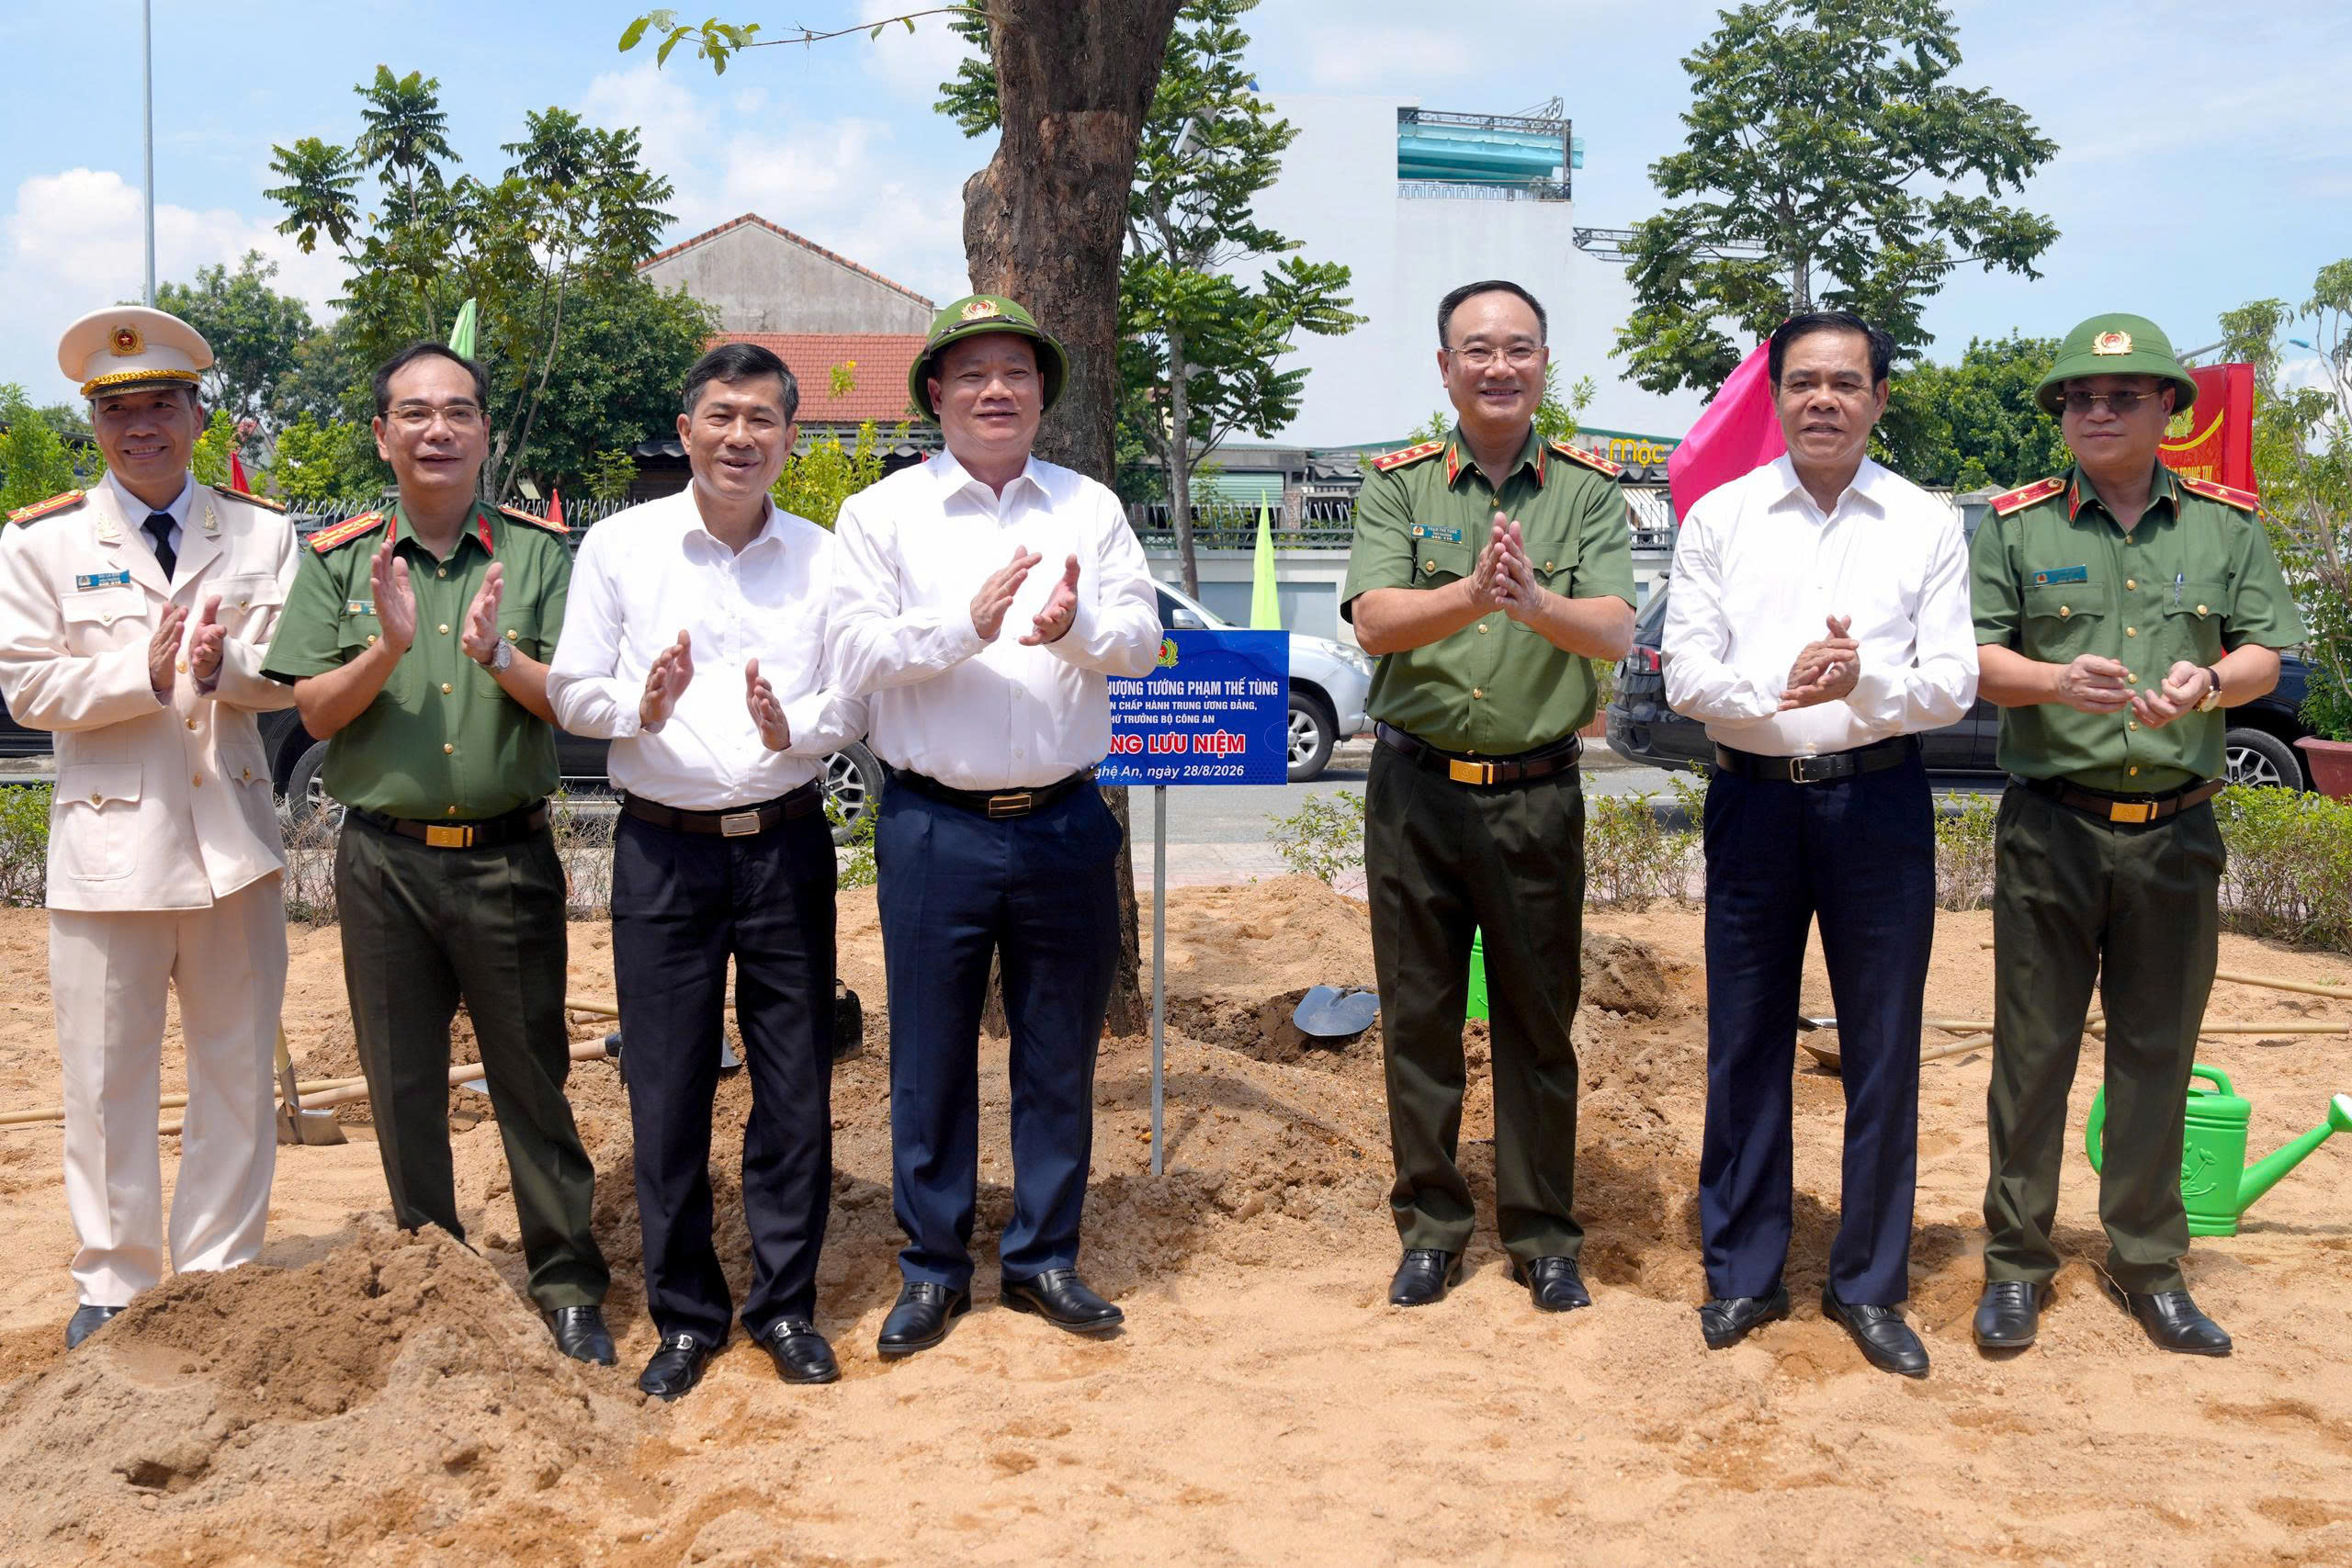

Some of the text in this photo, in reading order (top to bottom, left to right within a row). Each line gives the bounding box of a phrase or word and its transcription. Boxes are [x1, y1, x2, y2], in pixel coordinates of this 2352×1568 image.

[1107, 677, 1278, 698] HƯỢNG TƯỚNG PHẠM THẾ TÙNG
[1119, 698, 1143, 710] CHẤP
[1145, 699, 1170, 710] HÀNH
[1172, 701, 1201, 710] TRUNG
[1204, 700, 1228, 710] ƯƠNG
[1230, 698, 1258, 711] ĐẢNG,
[1124, 713, 1159, 724] TRƯỞNG
[1161, 714, 1173, 725] BỘ
[1175, 714, 1199, 724] CÔNG
[1202, 715, 1215, 724] AN
[1148, 731, 1188, 754] LƯU
[1193, 729, 1246, 759] NIỆM
[1091, 764, 1245, 779] ghệ An, ngày 28/8/2026
